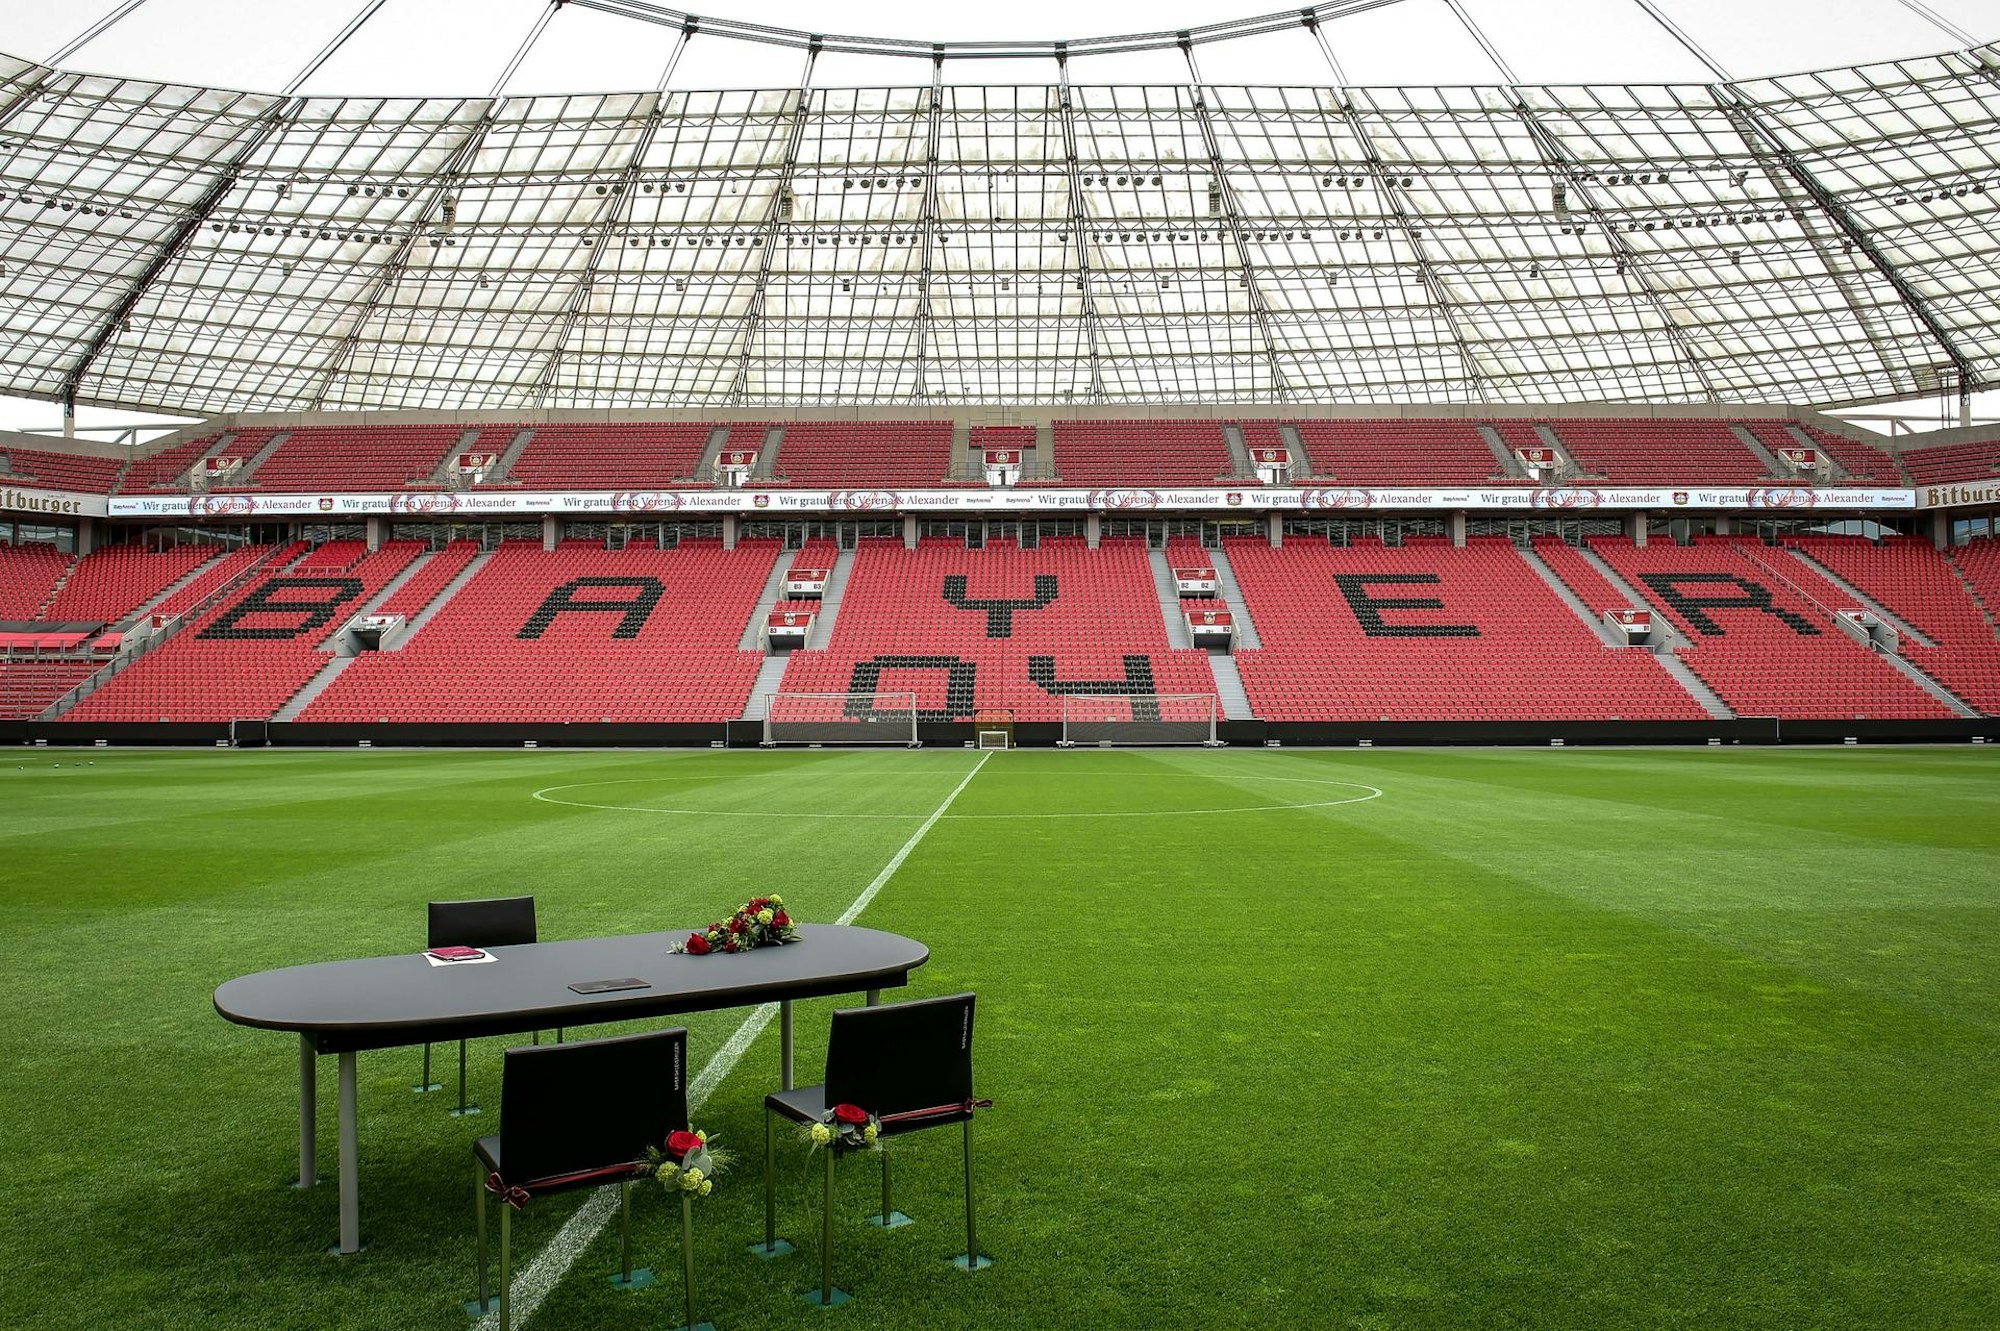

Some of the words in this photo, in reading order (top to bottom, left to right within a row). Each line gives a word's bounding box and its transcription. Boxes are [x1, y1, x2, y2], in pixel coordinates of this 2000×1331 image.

[143, 501, 160, 510] Wir
[162, 501, 213, 512] gratulieren
[218, 500, 251, 509] Verena
[252, 500, 259, 509] &
[262, 500, 311, 509] Alexander
[342, 500, 360, 509] Wir
[362, 500, 415, 511] gratulieren
[418, 499, 452, 508] Verena
[455, 499, 462, 508] &
[465, 499, 516, 508] Alexander
[563, 498, 580, 507] Wir
[584, 498, 638, 509] gratulieren
[641, 497, 675, 506] Verena
[679, 497, 686, 506] &
[689, 497, 741, 506] Alexander
[779, 496, 797, 505] Wir
[801, 496, 854, 508] gratulieren
[858, 496, 894, 505] Verena
[897, 496, 904, 505] &
[907, 496, 959, 505] Alexander
[1038, 495, 1056, 504] Wir
[1059, 495, 1114, 507] gratulieren
[1118, 495, 1154, 504] Verena
[1157, 495, 1164, 504] &
[1166, 495, 1218, 503] Alexander
[1251, 494, 1269, 503] Wir
[1272, 494, 1327, 506] gratulieren
[1331, 494, 1367, 503] Verena
[1370, 494, 1377, 503] &
[1380, 494, 1432, 503] Alexander
[1481, 494, 1498, 503] Wir
[1502, 494, 1557, 506] gratulieren
[1560, 494, 1597, 503] Verena
[1599, 494, 1606, 503] &
[1609, 494, 1660, 503] Alexander
[1699, 494, 1716, 503] Wir
[1719, 494, 1774, 506] gratulieren
[1777, 494, 1812, 503] Verena
[1815, 494, 1821, 503] &
[1824, 494, 1874, 503] Alexander
[194, 573, 1822, 640] BAYER
[842, 654, 1161, 723] 04
